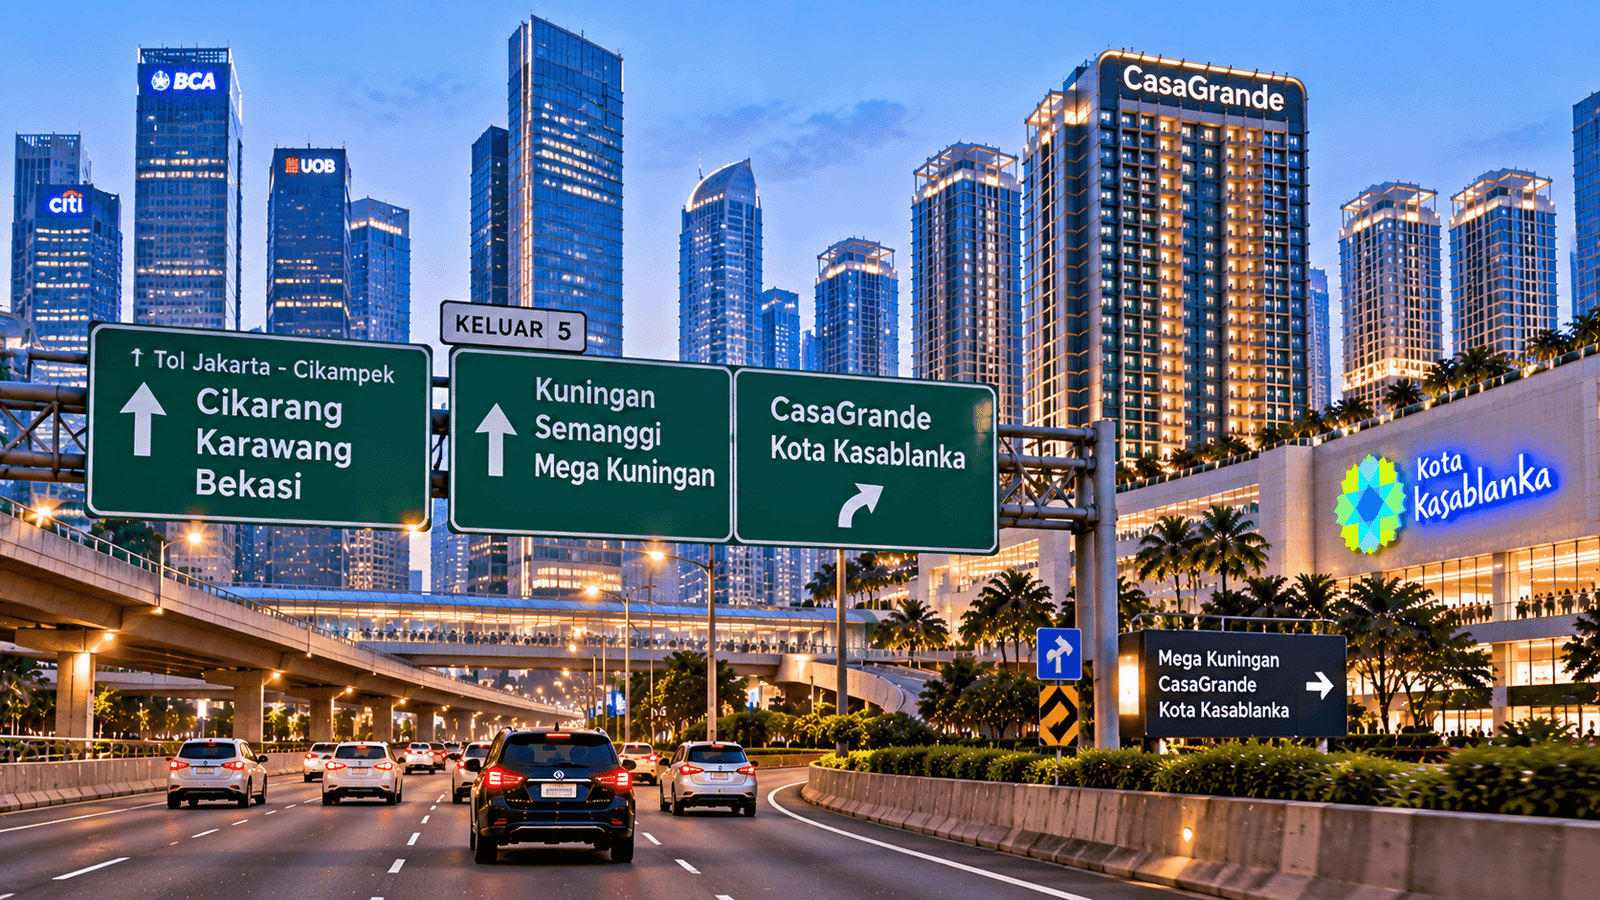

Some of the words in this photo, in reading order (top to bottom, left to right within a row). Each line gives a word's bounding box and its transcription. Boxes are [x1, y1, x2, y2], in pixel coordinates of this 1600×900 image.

[173, 72, 216, 90] BCA
[1123, 64, 1285, 112] CasaGrande
[300, 158, 336, 174] UOB
[49, 193, 83, 214] citi
[456, 314, 543, 339] KELUAR
[557, 321, 572, 341] 5
[153, 349, 185, 370] Tol
[192, 353, 270, 376] Jakarta
[293, 359, 395, 387] Cikampek
[196, 387, 343, 429] Cikarang
[536, 376, 656, 412] Kuningan
[770, 395, 932, 431] CasaGrande
[196, 427, 352, 469] Karawang
[535, 413, 661, 452] Semanggi
[771, 434, 826, 462] Kota
[834, 438, 966, 470] Kasablanka
[1417, 451, 1463, 482] Kota
[195, 468, 302, 500] Bekasi
[534, 452, 600, 486] Mega
[606, 456, 715, 492] Kuningan
[1158, 649, 1202, 671] Mega
[1206, 650, 1280, 672] Kuningan
[1158, 675, 1257, 693] CasaGrande
[1159, 700, 1196, 718] Kota
[1200, 701, 1290, 719] Kasablanka
